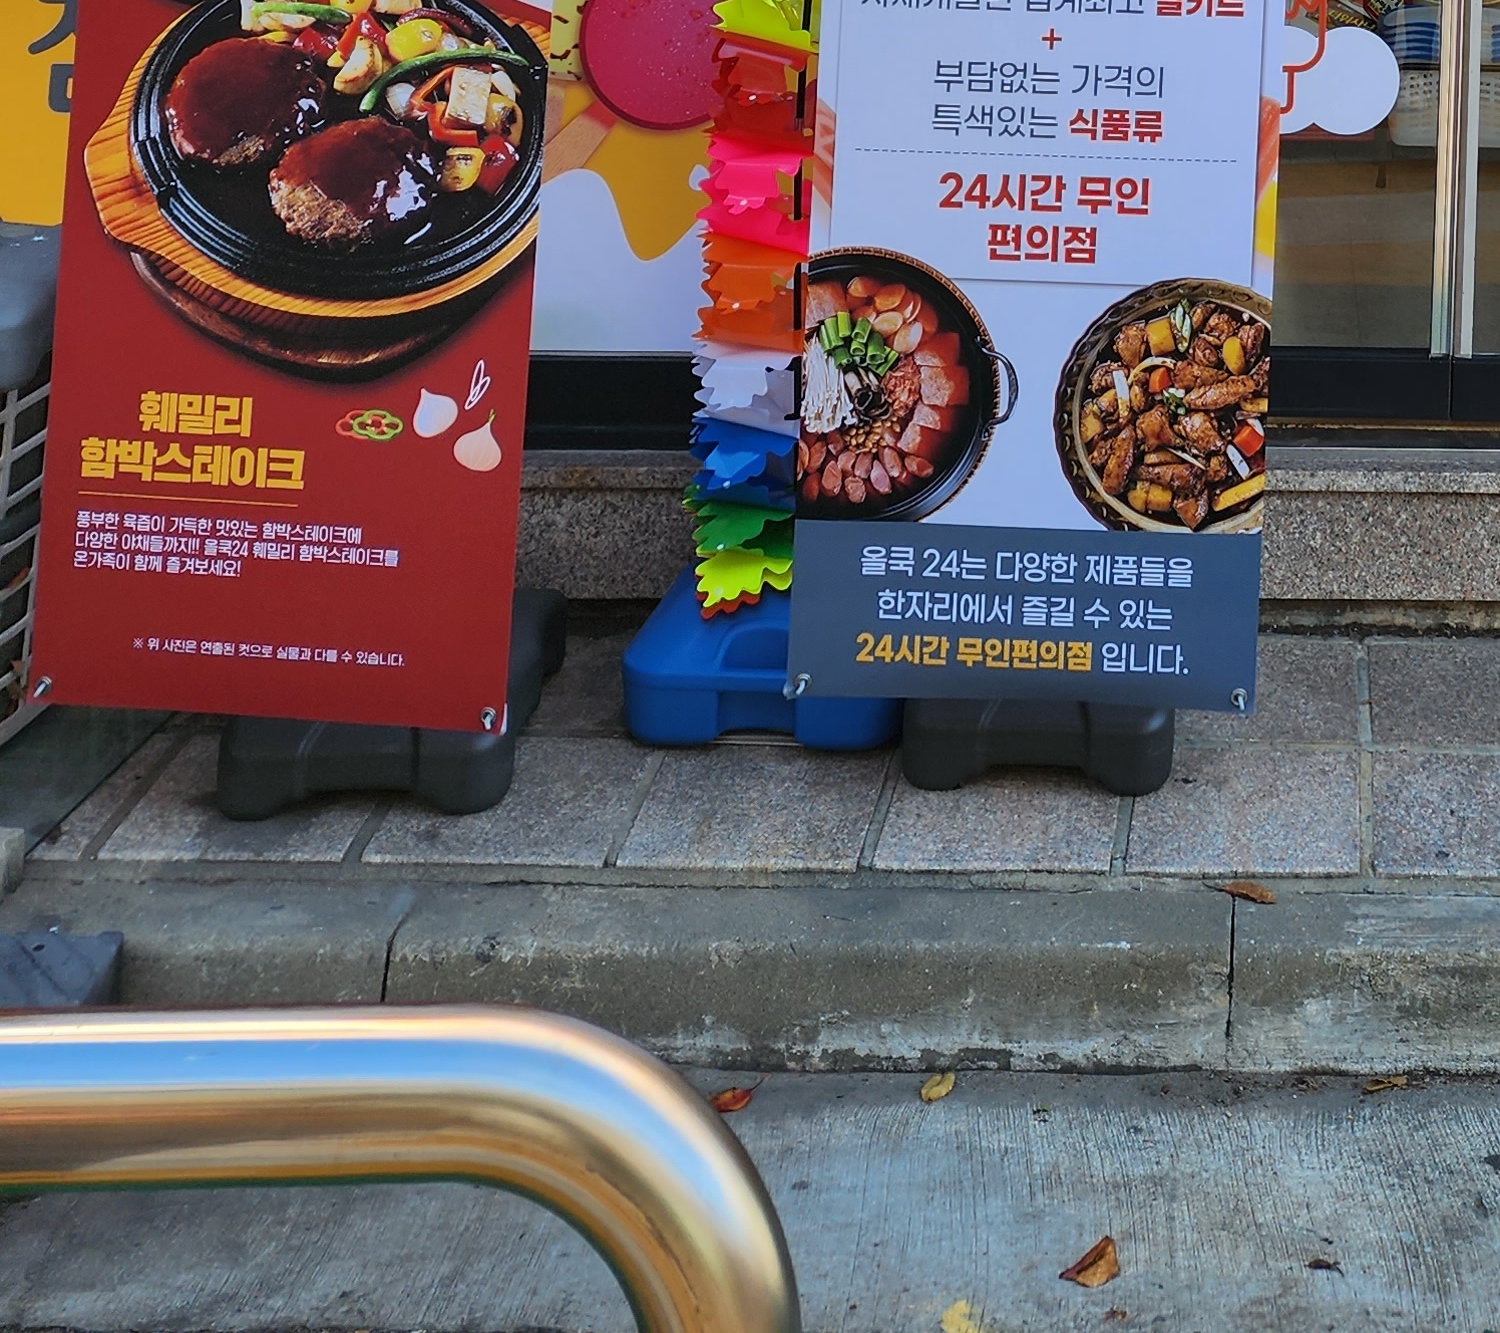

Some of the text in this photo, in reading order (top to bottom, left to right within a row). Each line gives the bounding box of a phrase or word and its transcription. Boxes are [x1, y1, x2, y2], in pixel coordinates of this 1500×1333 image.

[934, 60, 1164, 98] 부담없는 가격의
[931, 103, 1164, 143] 특색있는 식품류
[938, 171, 1151, 215] 24시간 무인
[987, 223, 1097, 264] 편의점
[138, 390, 253, 438] 훼밀리
[80, 435, 305, 490] 함박스테이크
[76, 510, 362, 544] 풍부한 육즙이 가득한 맛있는 함박스테이크에
[73, 549, 241, 579] 온가족이 함께 즐겨보세요!
[75, 529, 399, 568] 다양한 야채들까지!! 올쿡24 훼밀리 함박스테이크를
[860, 545, 1194, 588] 올쿡 24는 다양한 제품들을
[877, 588, 1173, 631] 한자리에서 즐길 수 있는
[147, 636, 160, 651] 위
[162, 638, 197, 655] 사진은
[315, 647, 337, 664] 다를
[340, 649, 353, 664] 수
[356, 650, 406, 668] 있습니다.
[855, 633, 1189, 676] 24시간 무인편의점 입니다.
